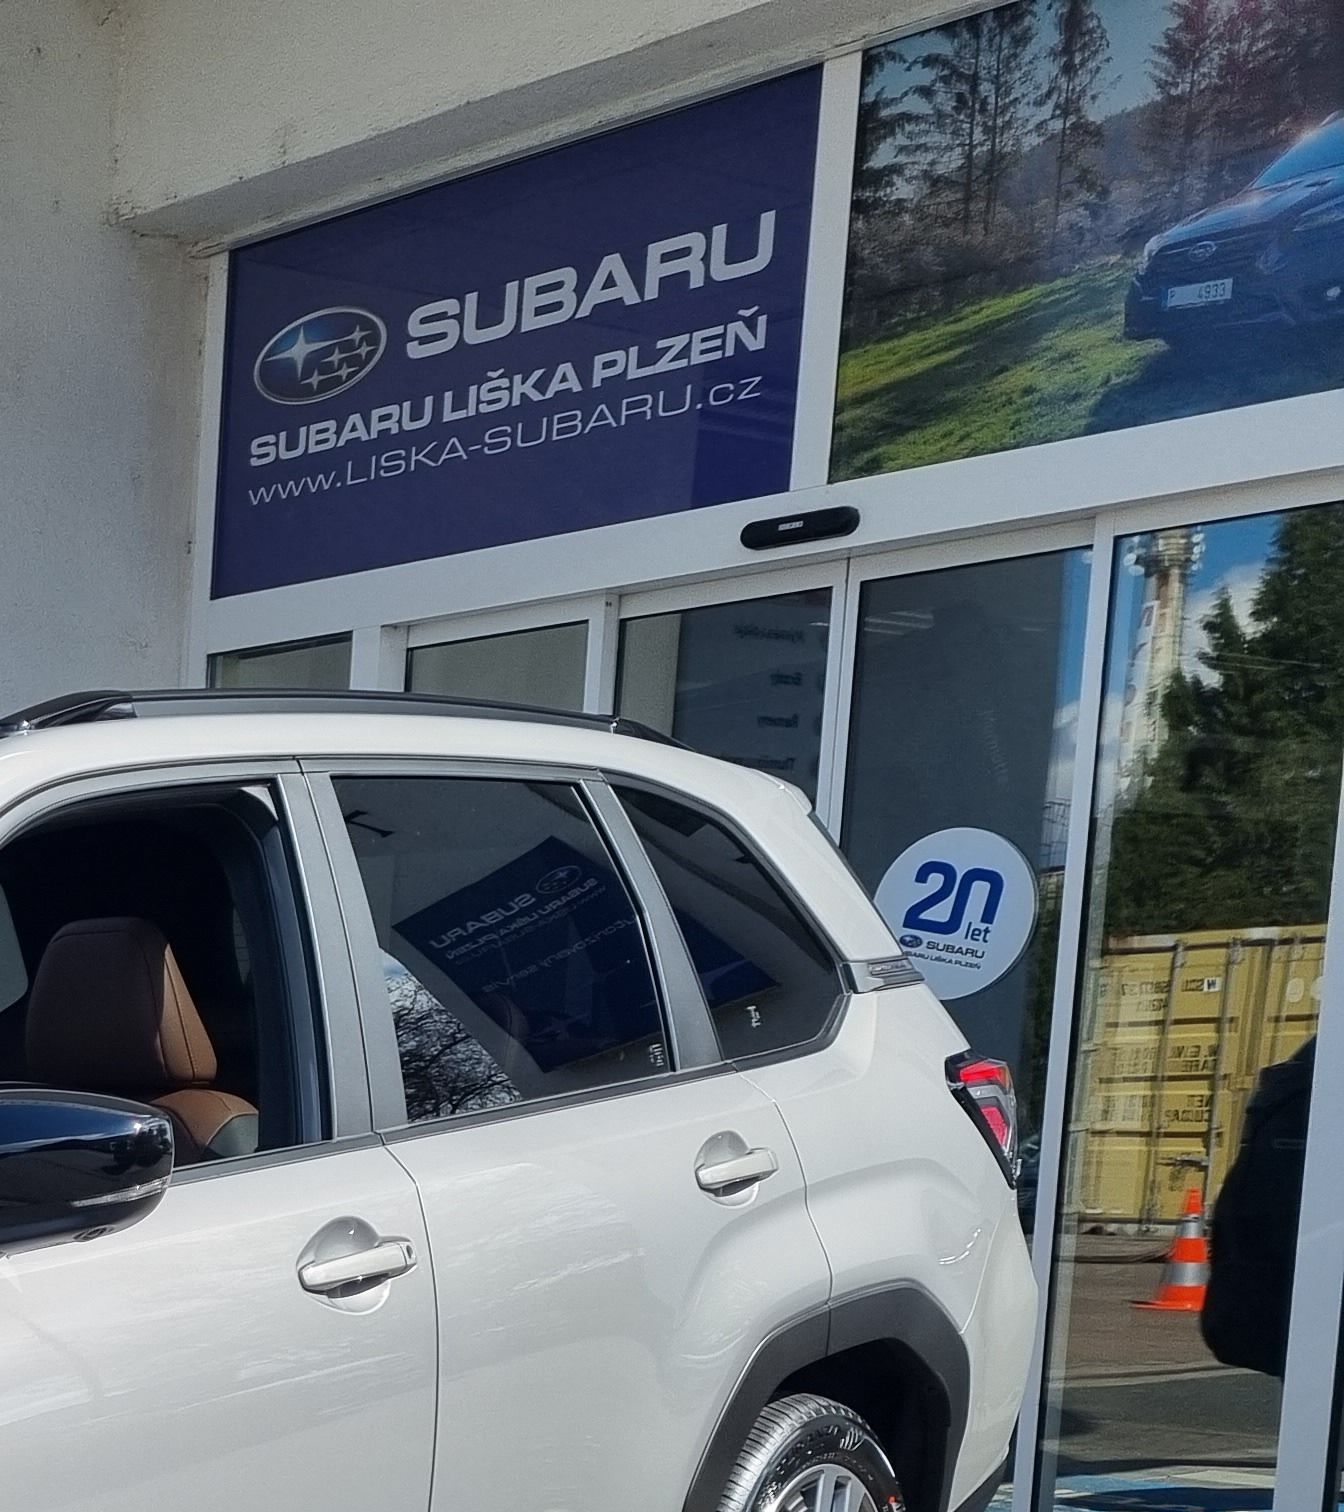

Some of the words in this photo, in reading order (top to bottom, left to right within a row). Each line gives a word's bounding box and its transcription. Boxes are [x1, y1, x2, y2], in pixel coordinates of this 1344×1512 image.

[406, 210, 777, 360] SUBARU
[249, 396, 435, 468] SUBARU
[441, 362, 583, 424] LIŠKA
[592, 306, 768, 382] PLZEŇ
[247, 374, 763, 506] www.LISKA-SUBARU.cz
[902, 860, 1004, 937] 20
[926, 940, 985, 959] SUBARU
[964, 922, 991, 943] let
